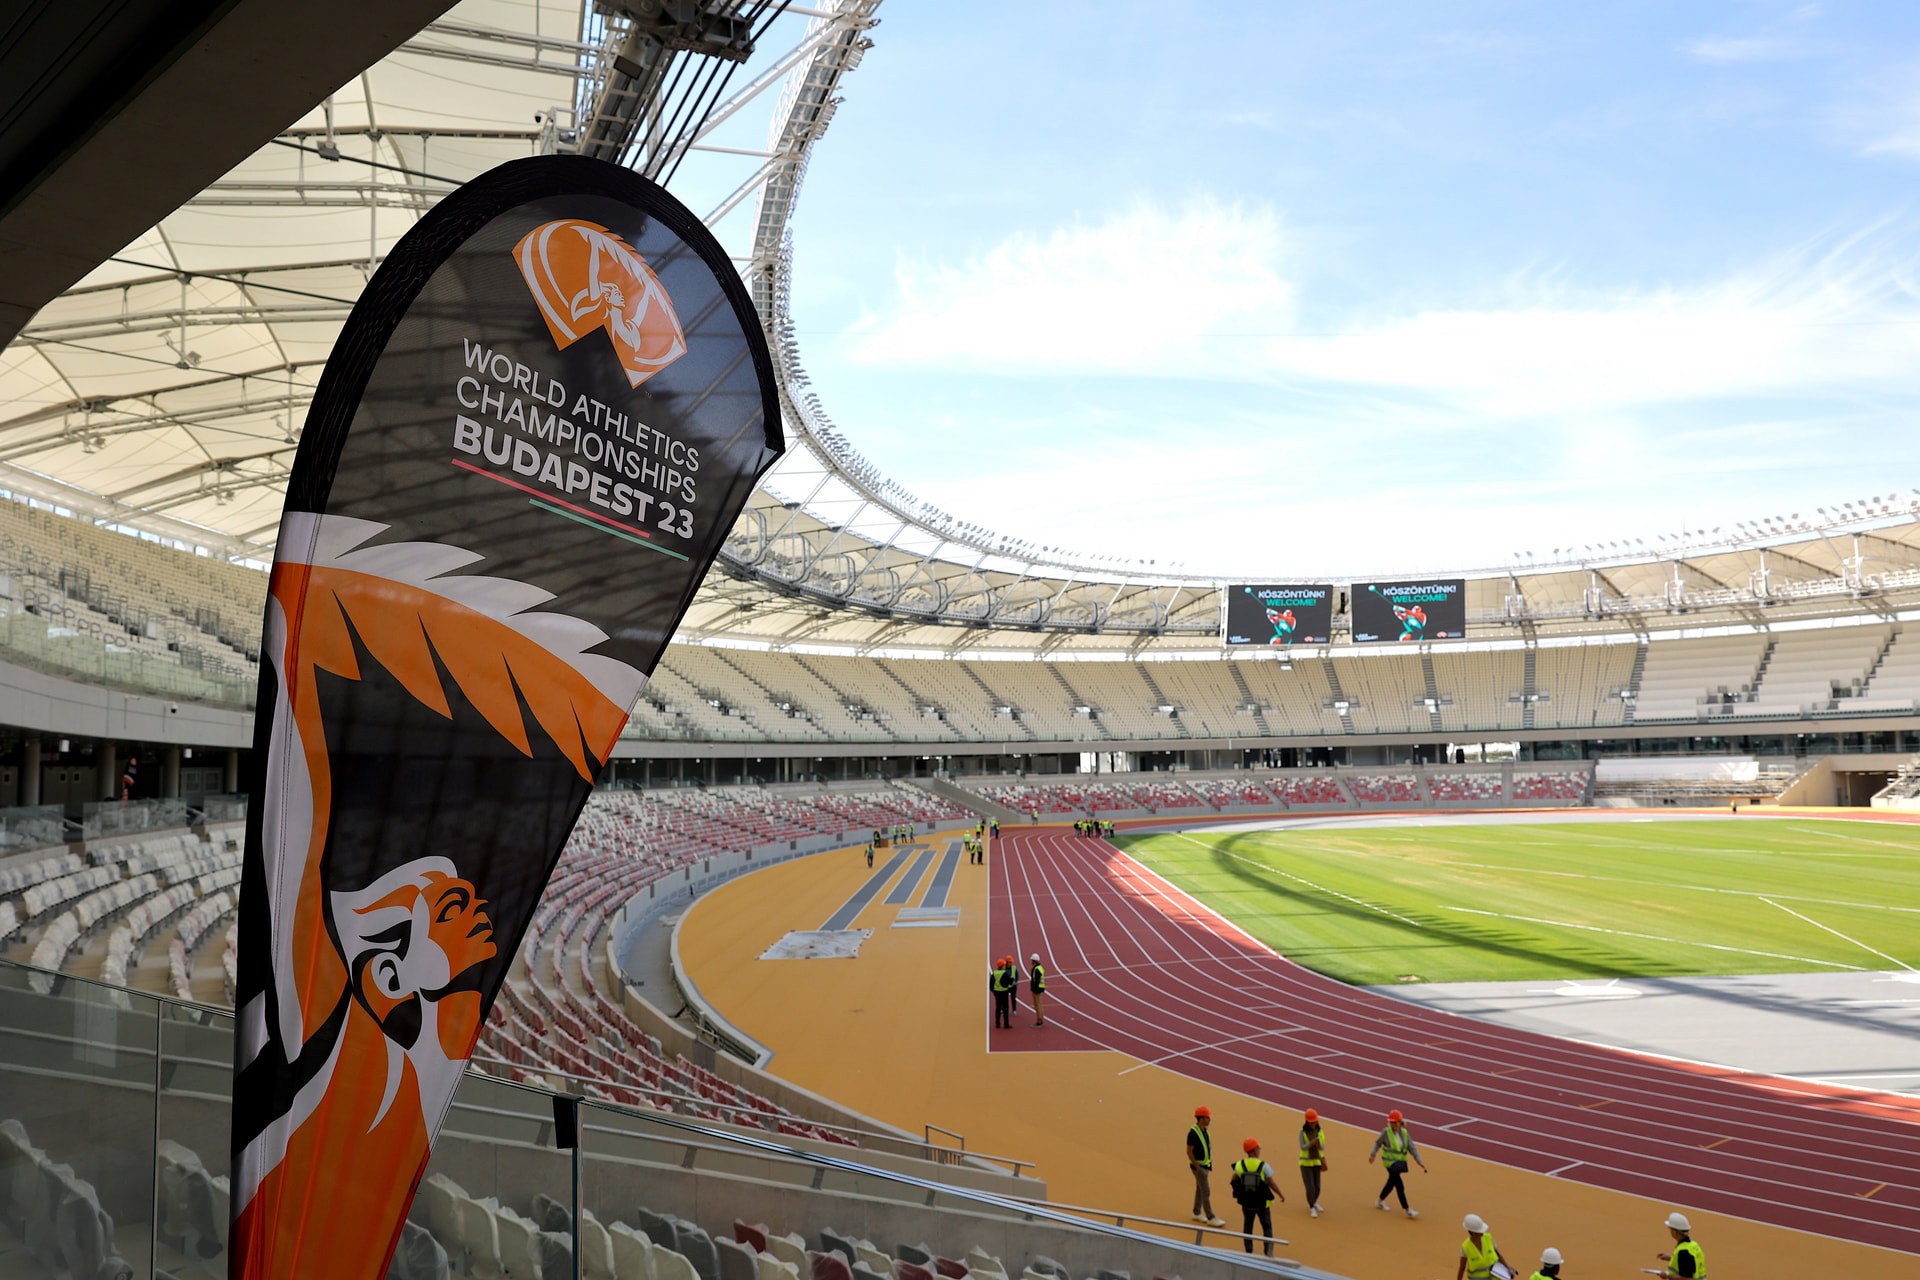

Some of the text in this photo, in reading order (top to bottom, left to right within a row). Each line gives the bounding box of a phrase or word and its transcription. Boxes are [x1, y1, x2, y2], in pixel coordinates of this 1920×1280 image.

[456, 375, 697, 504] CHAMPIONSHIPS
[463, 337, 700, 473] WORLD ATHLETICS
[452, 414, 695, 540] BUDAPEST 23
[1266, 598, 1317, 607] WELCOME!
[1392, 593, 1448, 603] WELCOME!
